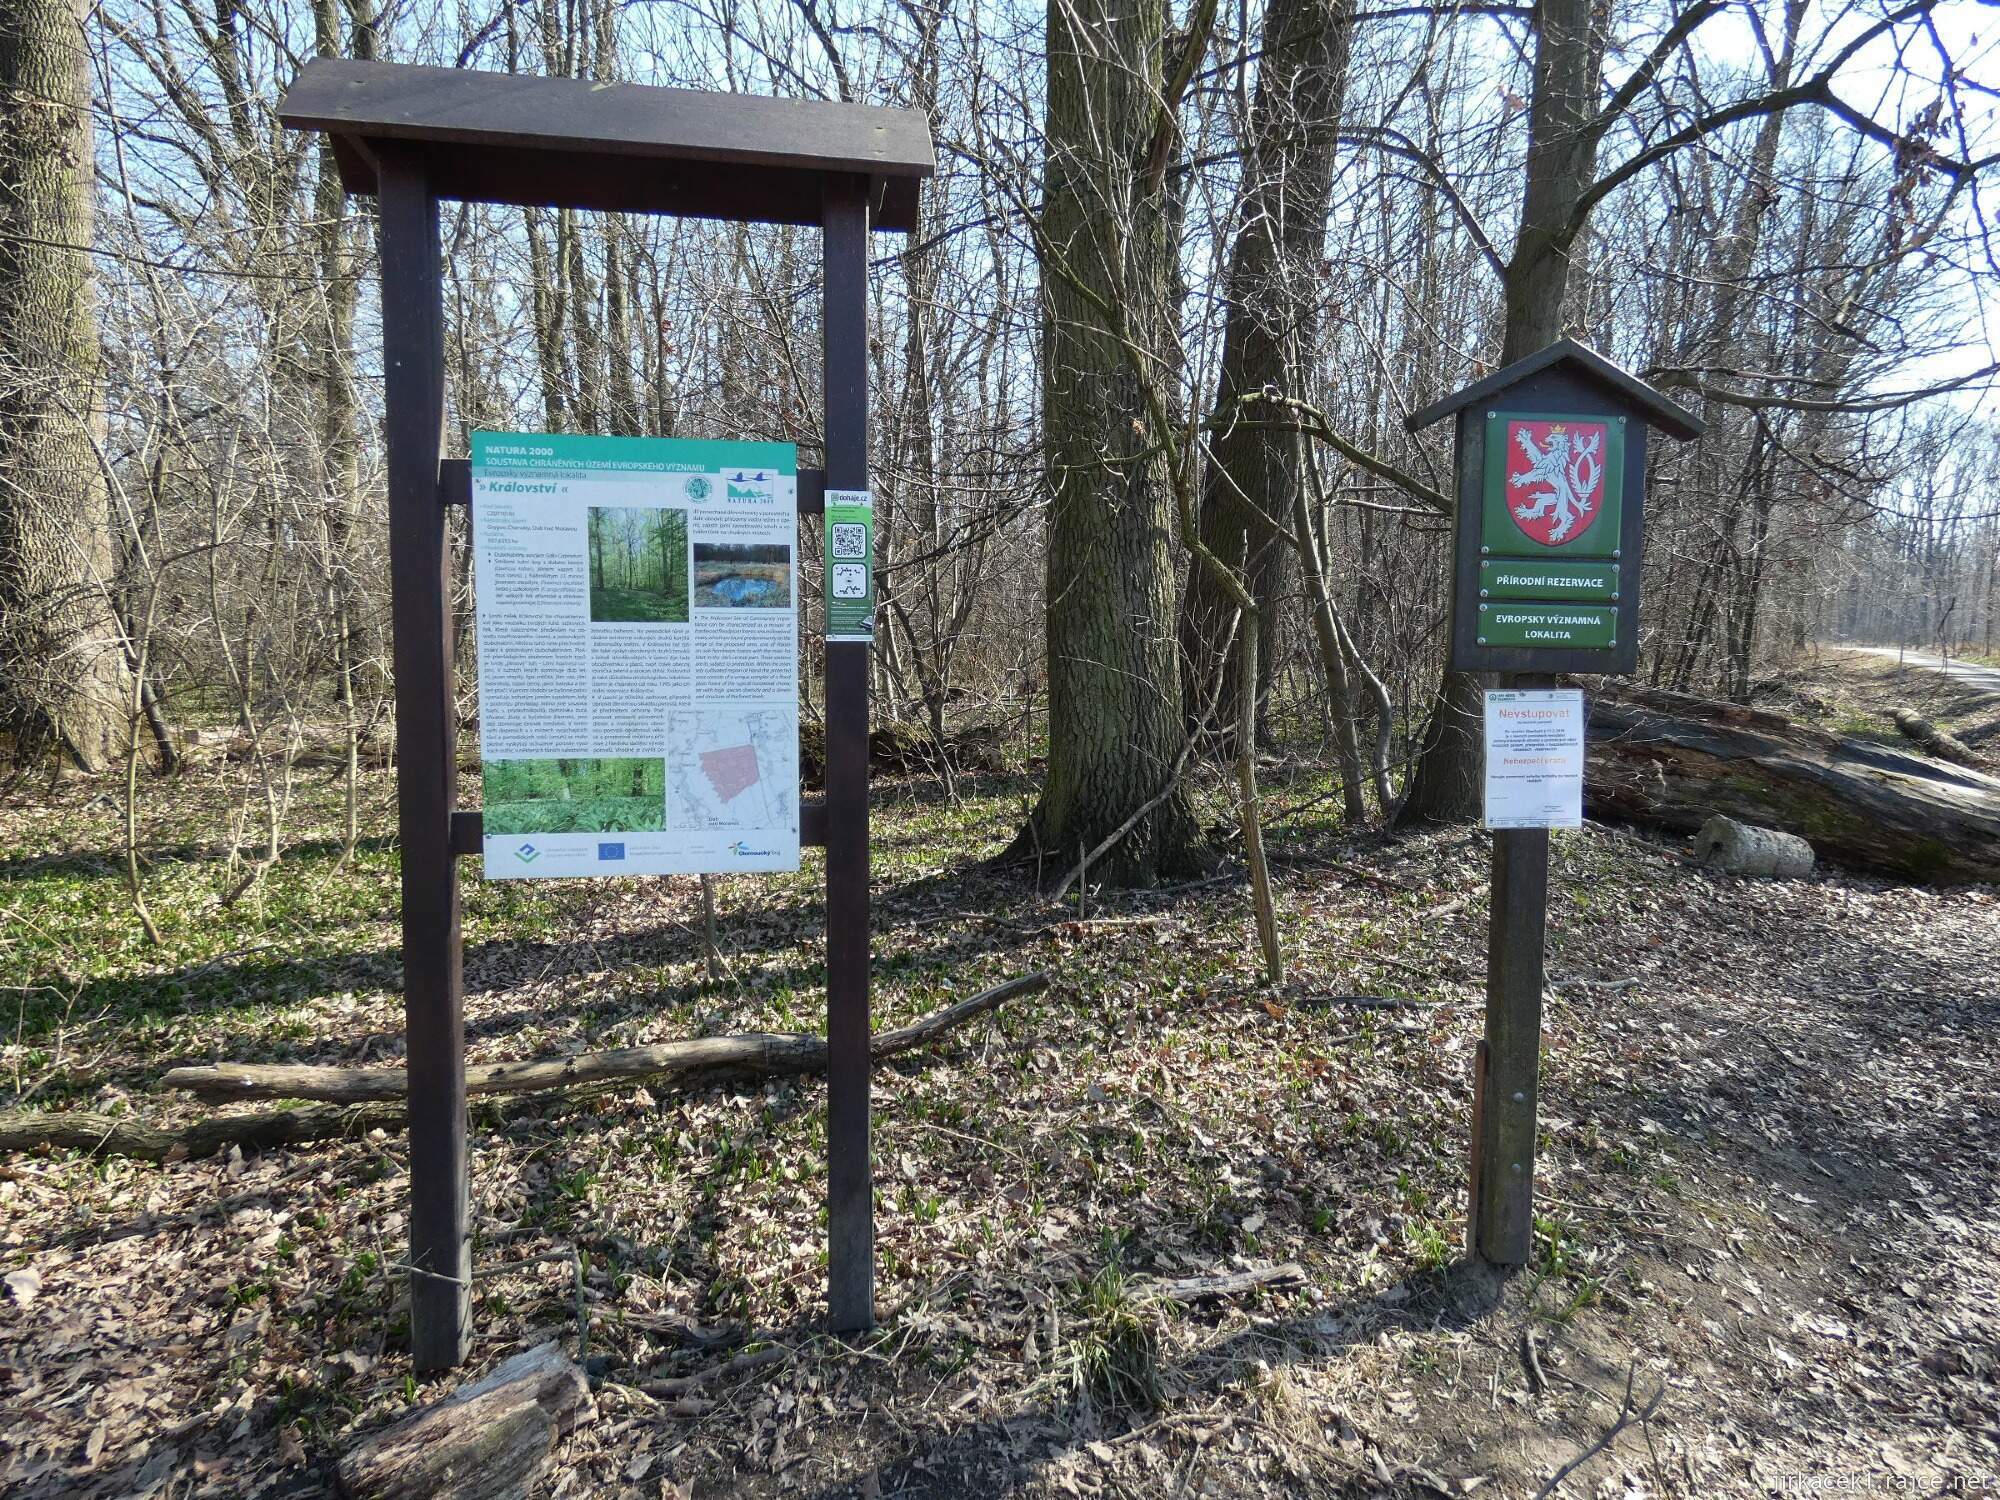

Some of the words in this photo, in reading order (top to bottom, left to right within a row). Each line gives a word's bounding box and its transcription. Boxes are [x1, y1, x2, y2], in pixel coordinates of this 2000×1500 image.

[485, 446, 527, 455] NATURA
[529, 447, 554, 456] 2000
[485, 457, 528, 466] SOUSTAVA
[560, 470, 587, 479] lokalita
[489, 481, 558, 493] Království
[1496, 574, 1545, 586] PŘÍRODNÍ
[1547, 577, 1605, 588] REZERVACE
[1496, 614, 1546, 624] EVROPSKY
[1547, 614, 1601, 625] VÝZNAMNÁ
[1525, 630, 1571, 639] LOKALITA
[1499, 708, 1570, 720] Nevstupovat
